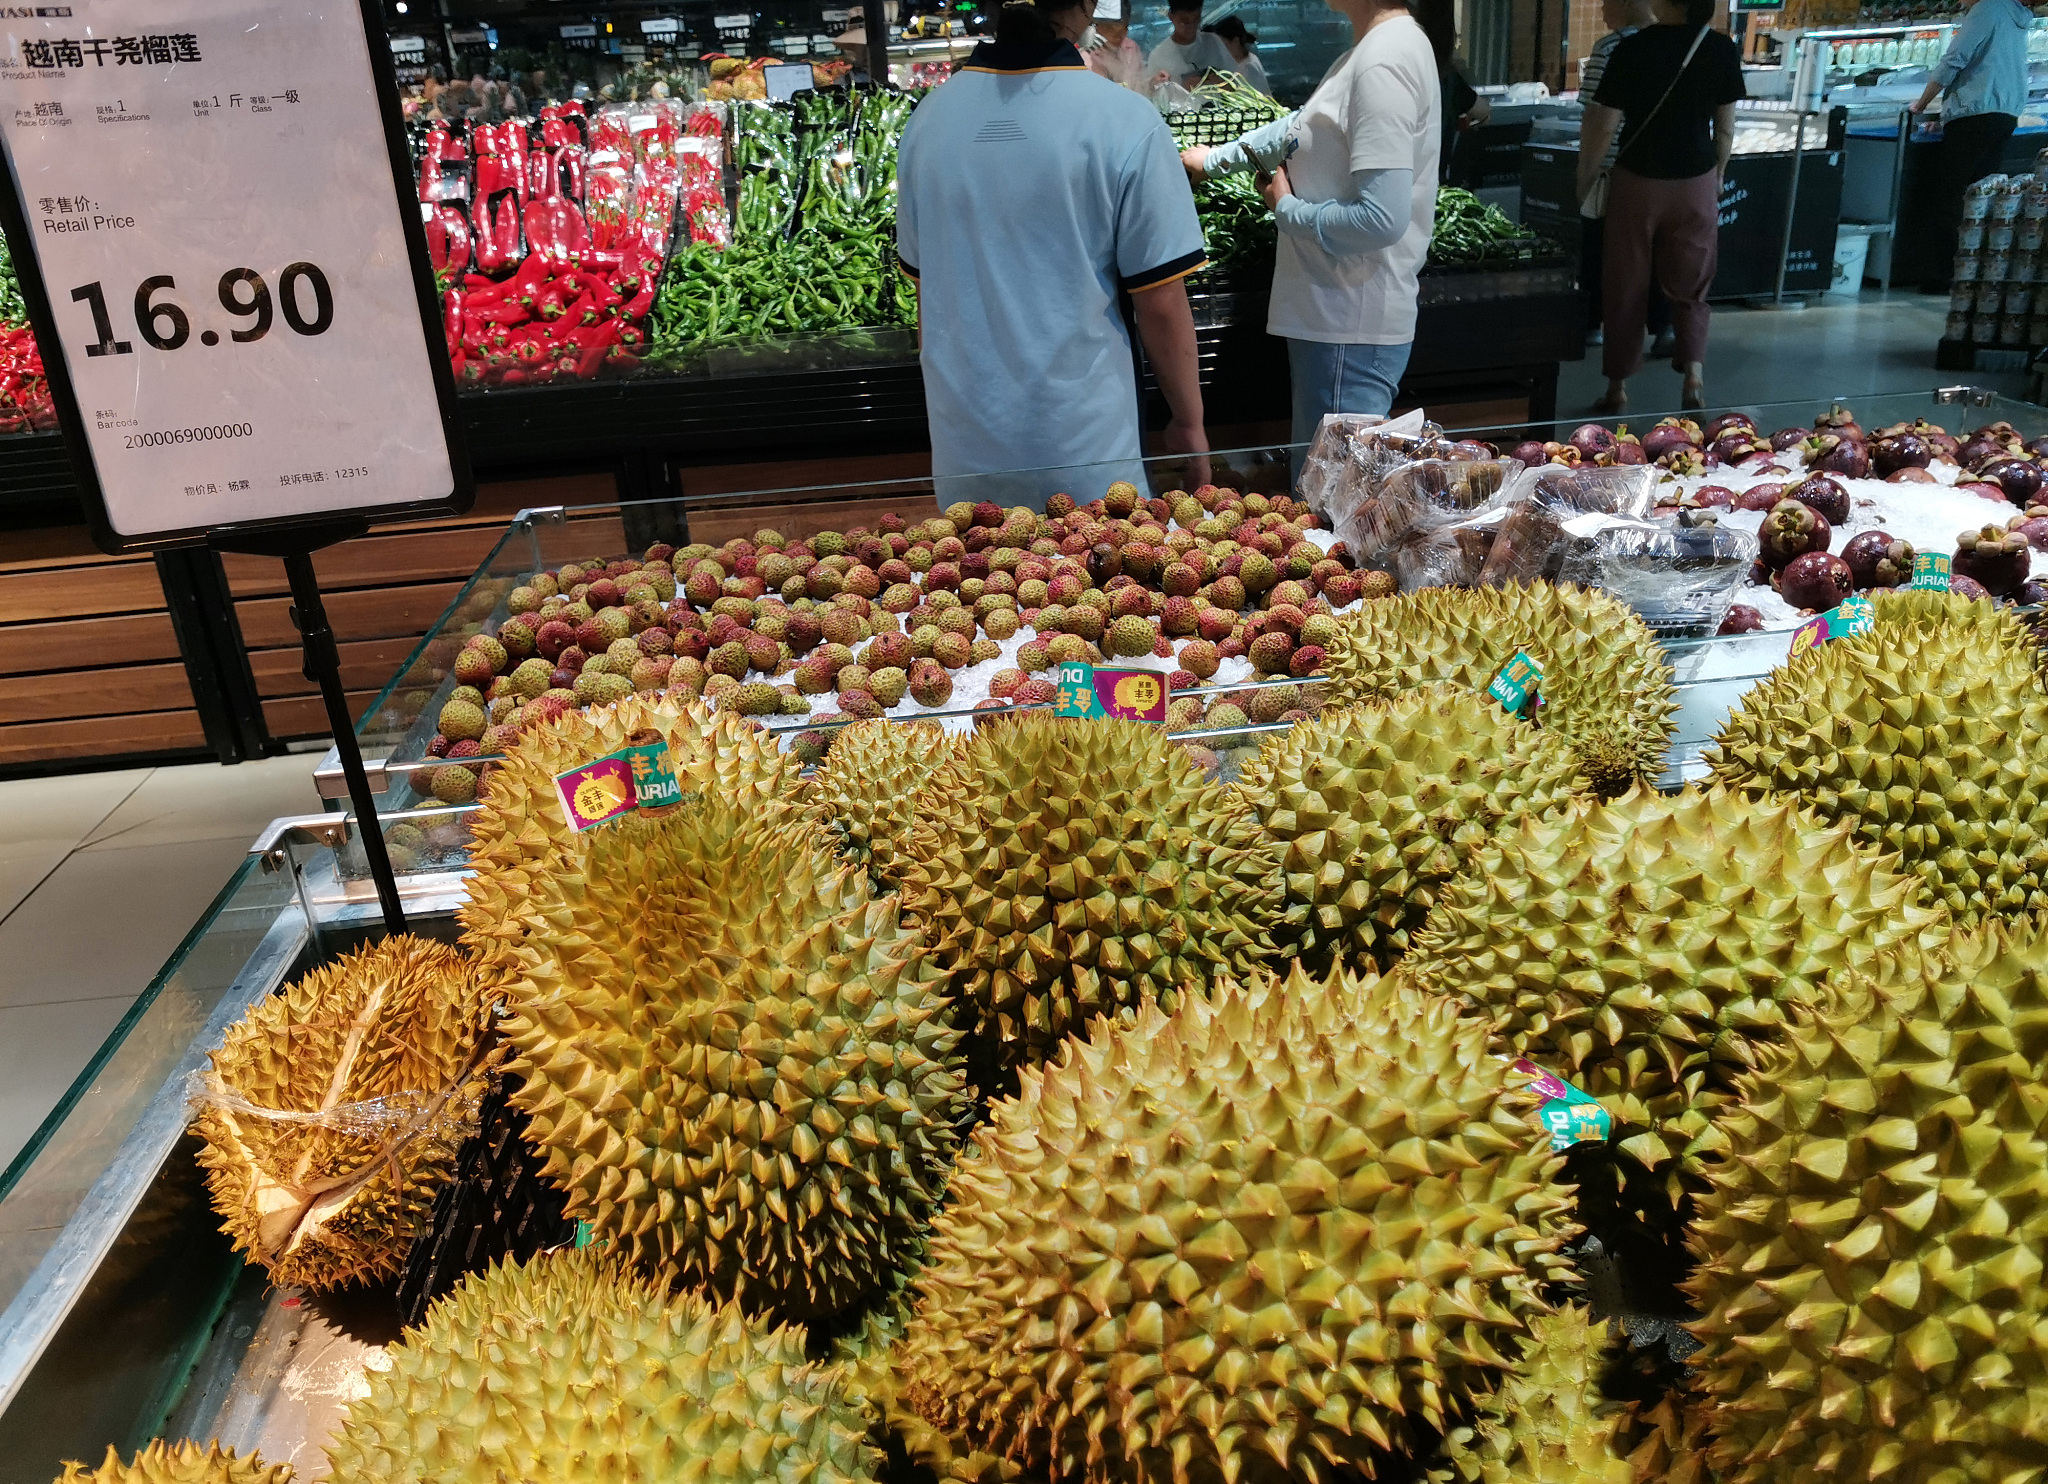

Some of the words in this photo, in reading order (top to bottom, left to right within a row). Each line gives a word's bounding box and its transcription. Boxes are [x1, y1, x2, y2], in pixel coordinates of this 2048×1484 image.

[21, 33, 202, 68] 越南干尧榴莲
[38, 70, 66, 79] Name
[212, 95, 221, 108] 1
[229, 93, 243, 108] 斤
[271, 89, 300, 103] 一级
[34, 101, 63, 116] 越南
[117, 100, 126, 112] 1
[193, 109, 209, 117] Unit
[251, 105, 272, 113] Class
[97, 113, 150, 124] Specifications
[39, 195, 99, 214] 零售价:
[43, 217, 90, 234] Retail
[93, 214, 135, 230] Price
[70, 261, 334, 358] 16.90
[123, 422, 253, 449] 2000069000000
[580, 789, 605, 808] 金丰
